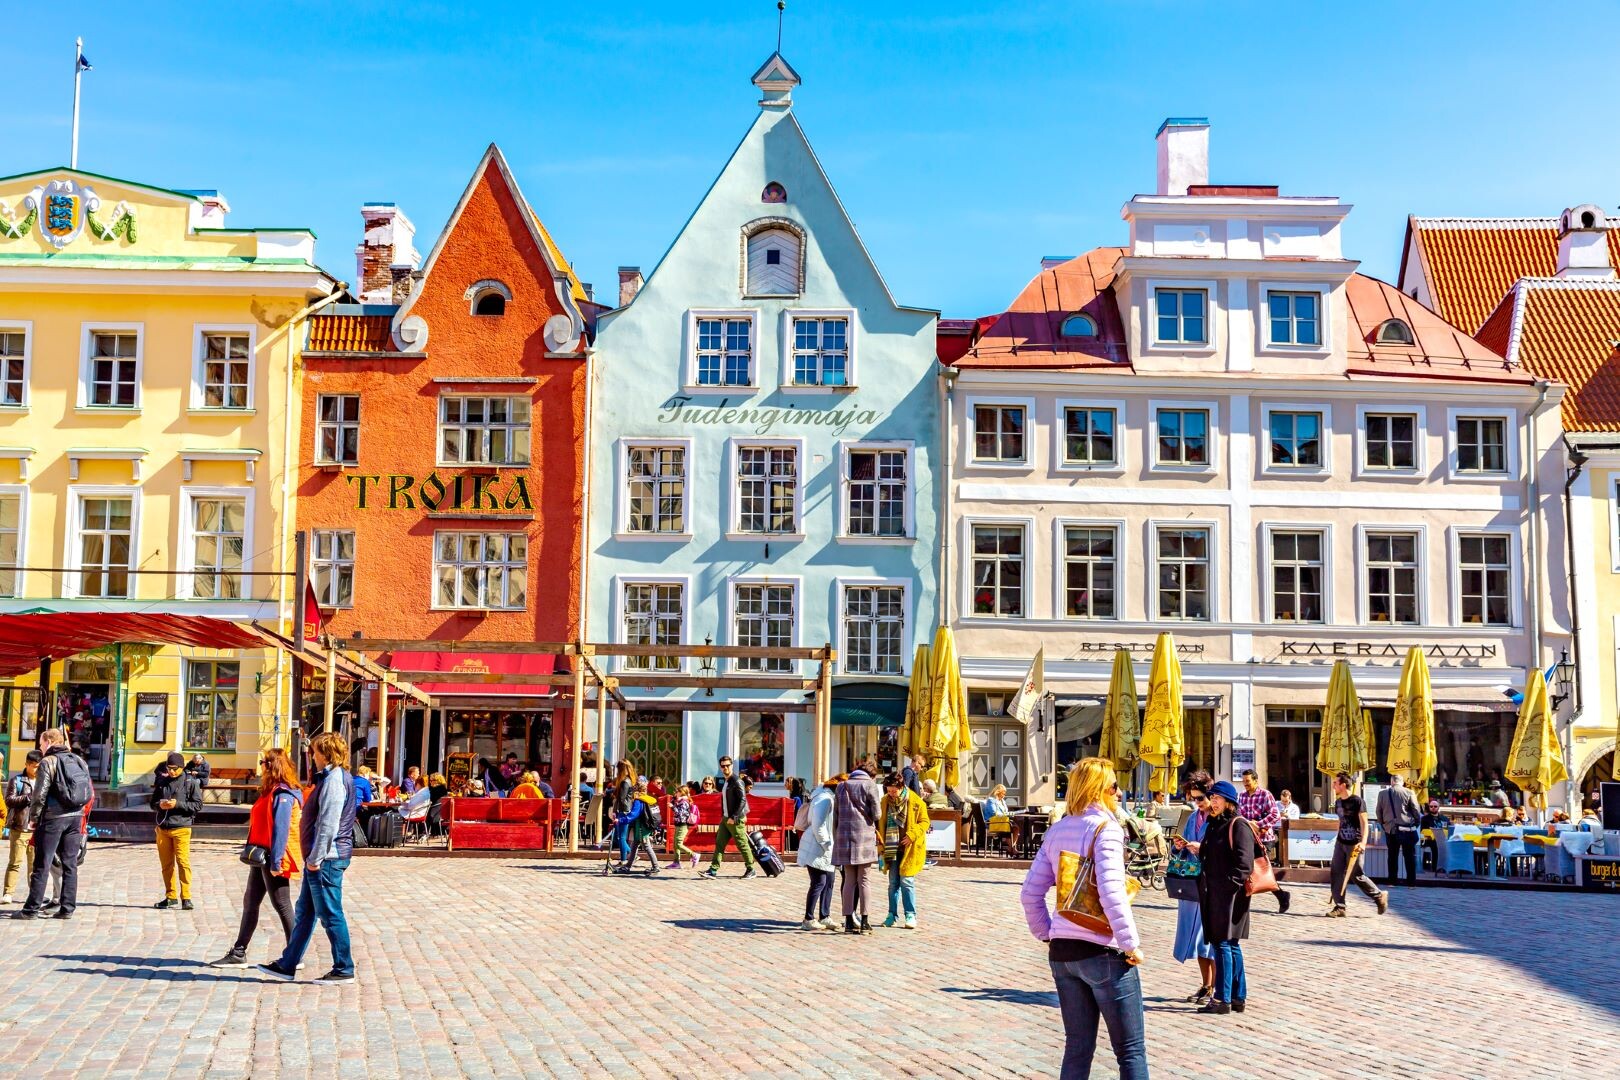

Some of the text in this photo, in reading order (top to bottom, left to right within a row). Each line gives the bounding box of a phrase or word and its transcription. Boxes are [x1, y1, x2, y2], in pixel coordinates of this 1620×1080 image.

[657, 396, 884, 437] Tudengimaja
[346, 471, 535, 512] TROIKA
[1081, 642, 1205, 653] RESTOAN
[1282, 641, 1496, 657] KAERAAAN
[1139, 745, 1154, 755] aku
[1511, 767, 1532, 776] saku
[1591, 861, 1610, 880] burger
